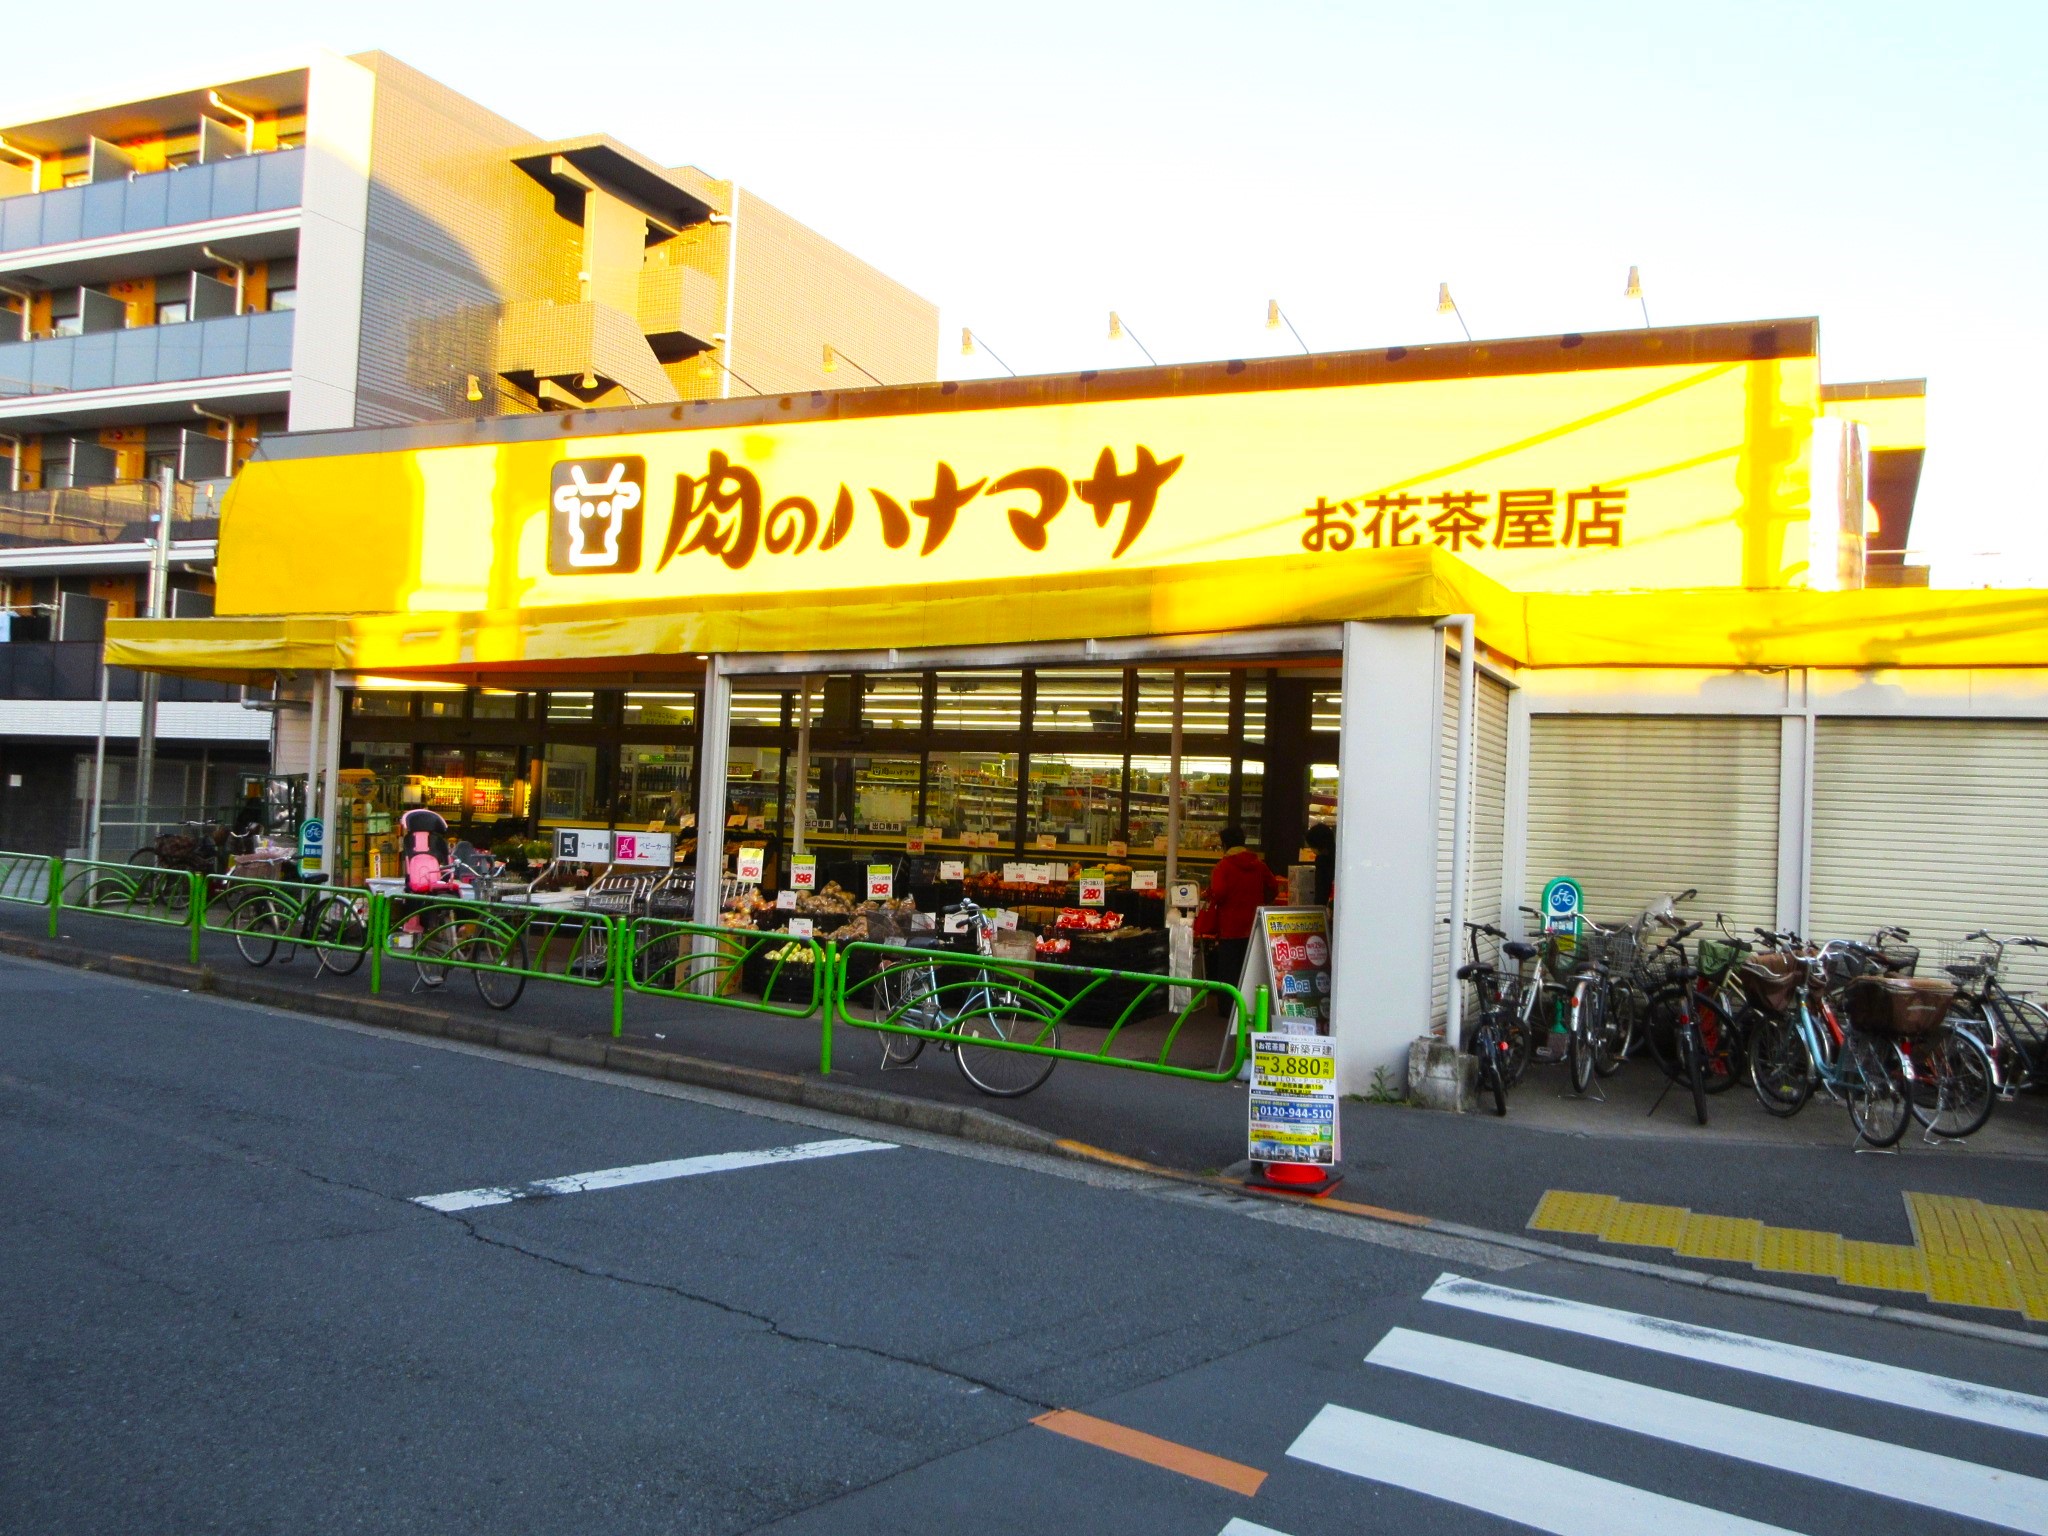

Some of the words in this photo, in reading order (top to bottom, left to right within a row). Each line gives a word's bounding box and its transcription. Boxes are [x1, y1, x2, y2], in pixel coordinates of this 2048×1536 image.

[656, 445, 1183, 573] 肉のハナマサ
[1301, 486, 1627, 552] お花茶屋店
[872, 822, 899, 831] 出口専用
[742, 867, 759, 877] 150
[795, 874, 812, 884] 198
[871, 884, 889, 894] 198
[1083, 889, 1101, 899] 280
[1276, 941, 1306, 960] 肉の日
[1284, 975, 1311, 993] 魚の日
[1290, 1043, 1332, 1055] 新築戸建
[1270, 1056, 1320, 1076] 3,880
[1260, 1105, 1332, 1119] 0120-944-510
